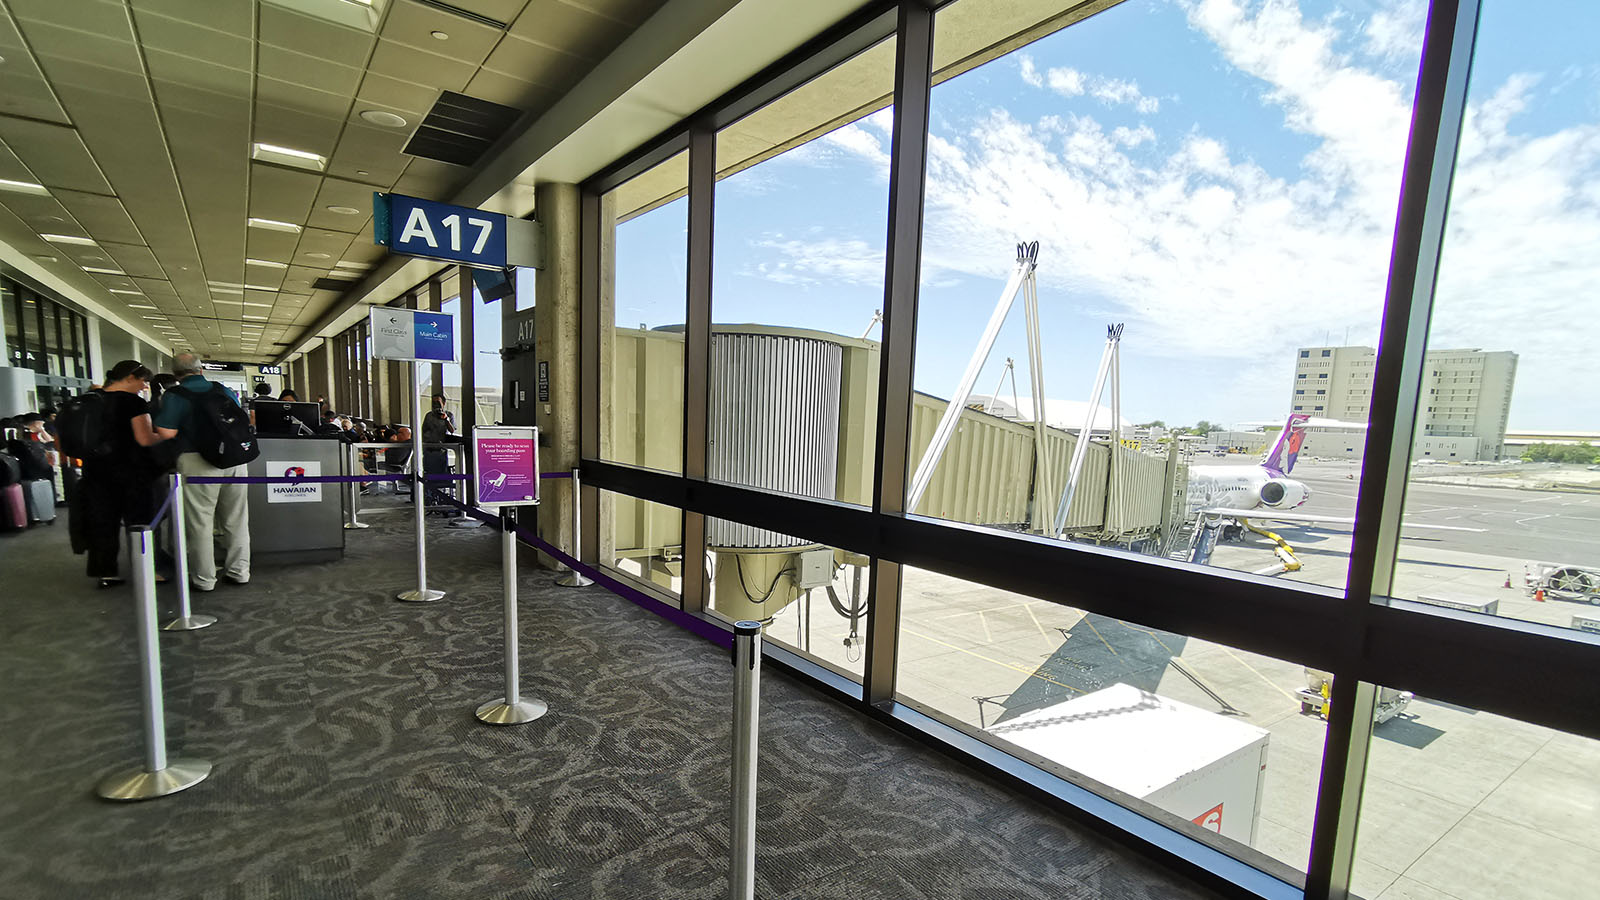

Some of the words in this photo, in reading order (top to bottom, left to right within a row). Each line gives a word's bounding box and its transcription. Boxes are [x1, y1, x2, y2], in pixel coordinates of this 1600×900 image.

[400, 207, 493, 255] A17
[518, 319, 534, 341] A17
[261, 366, 281, 374] A18
